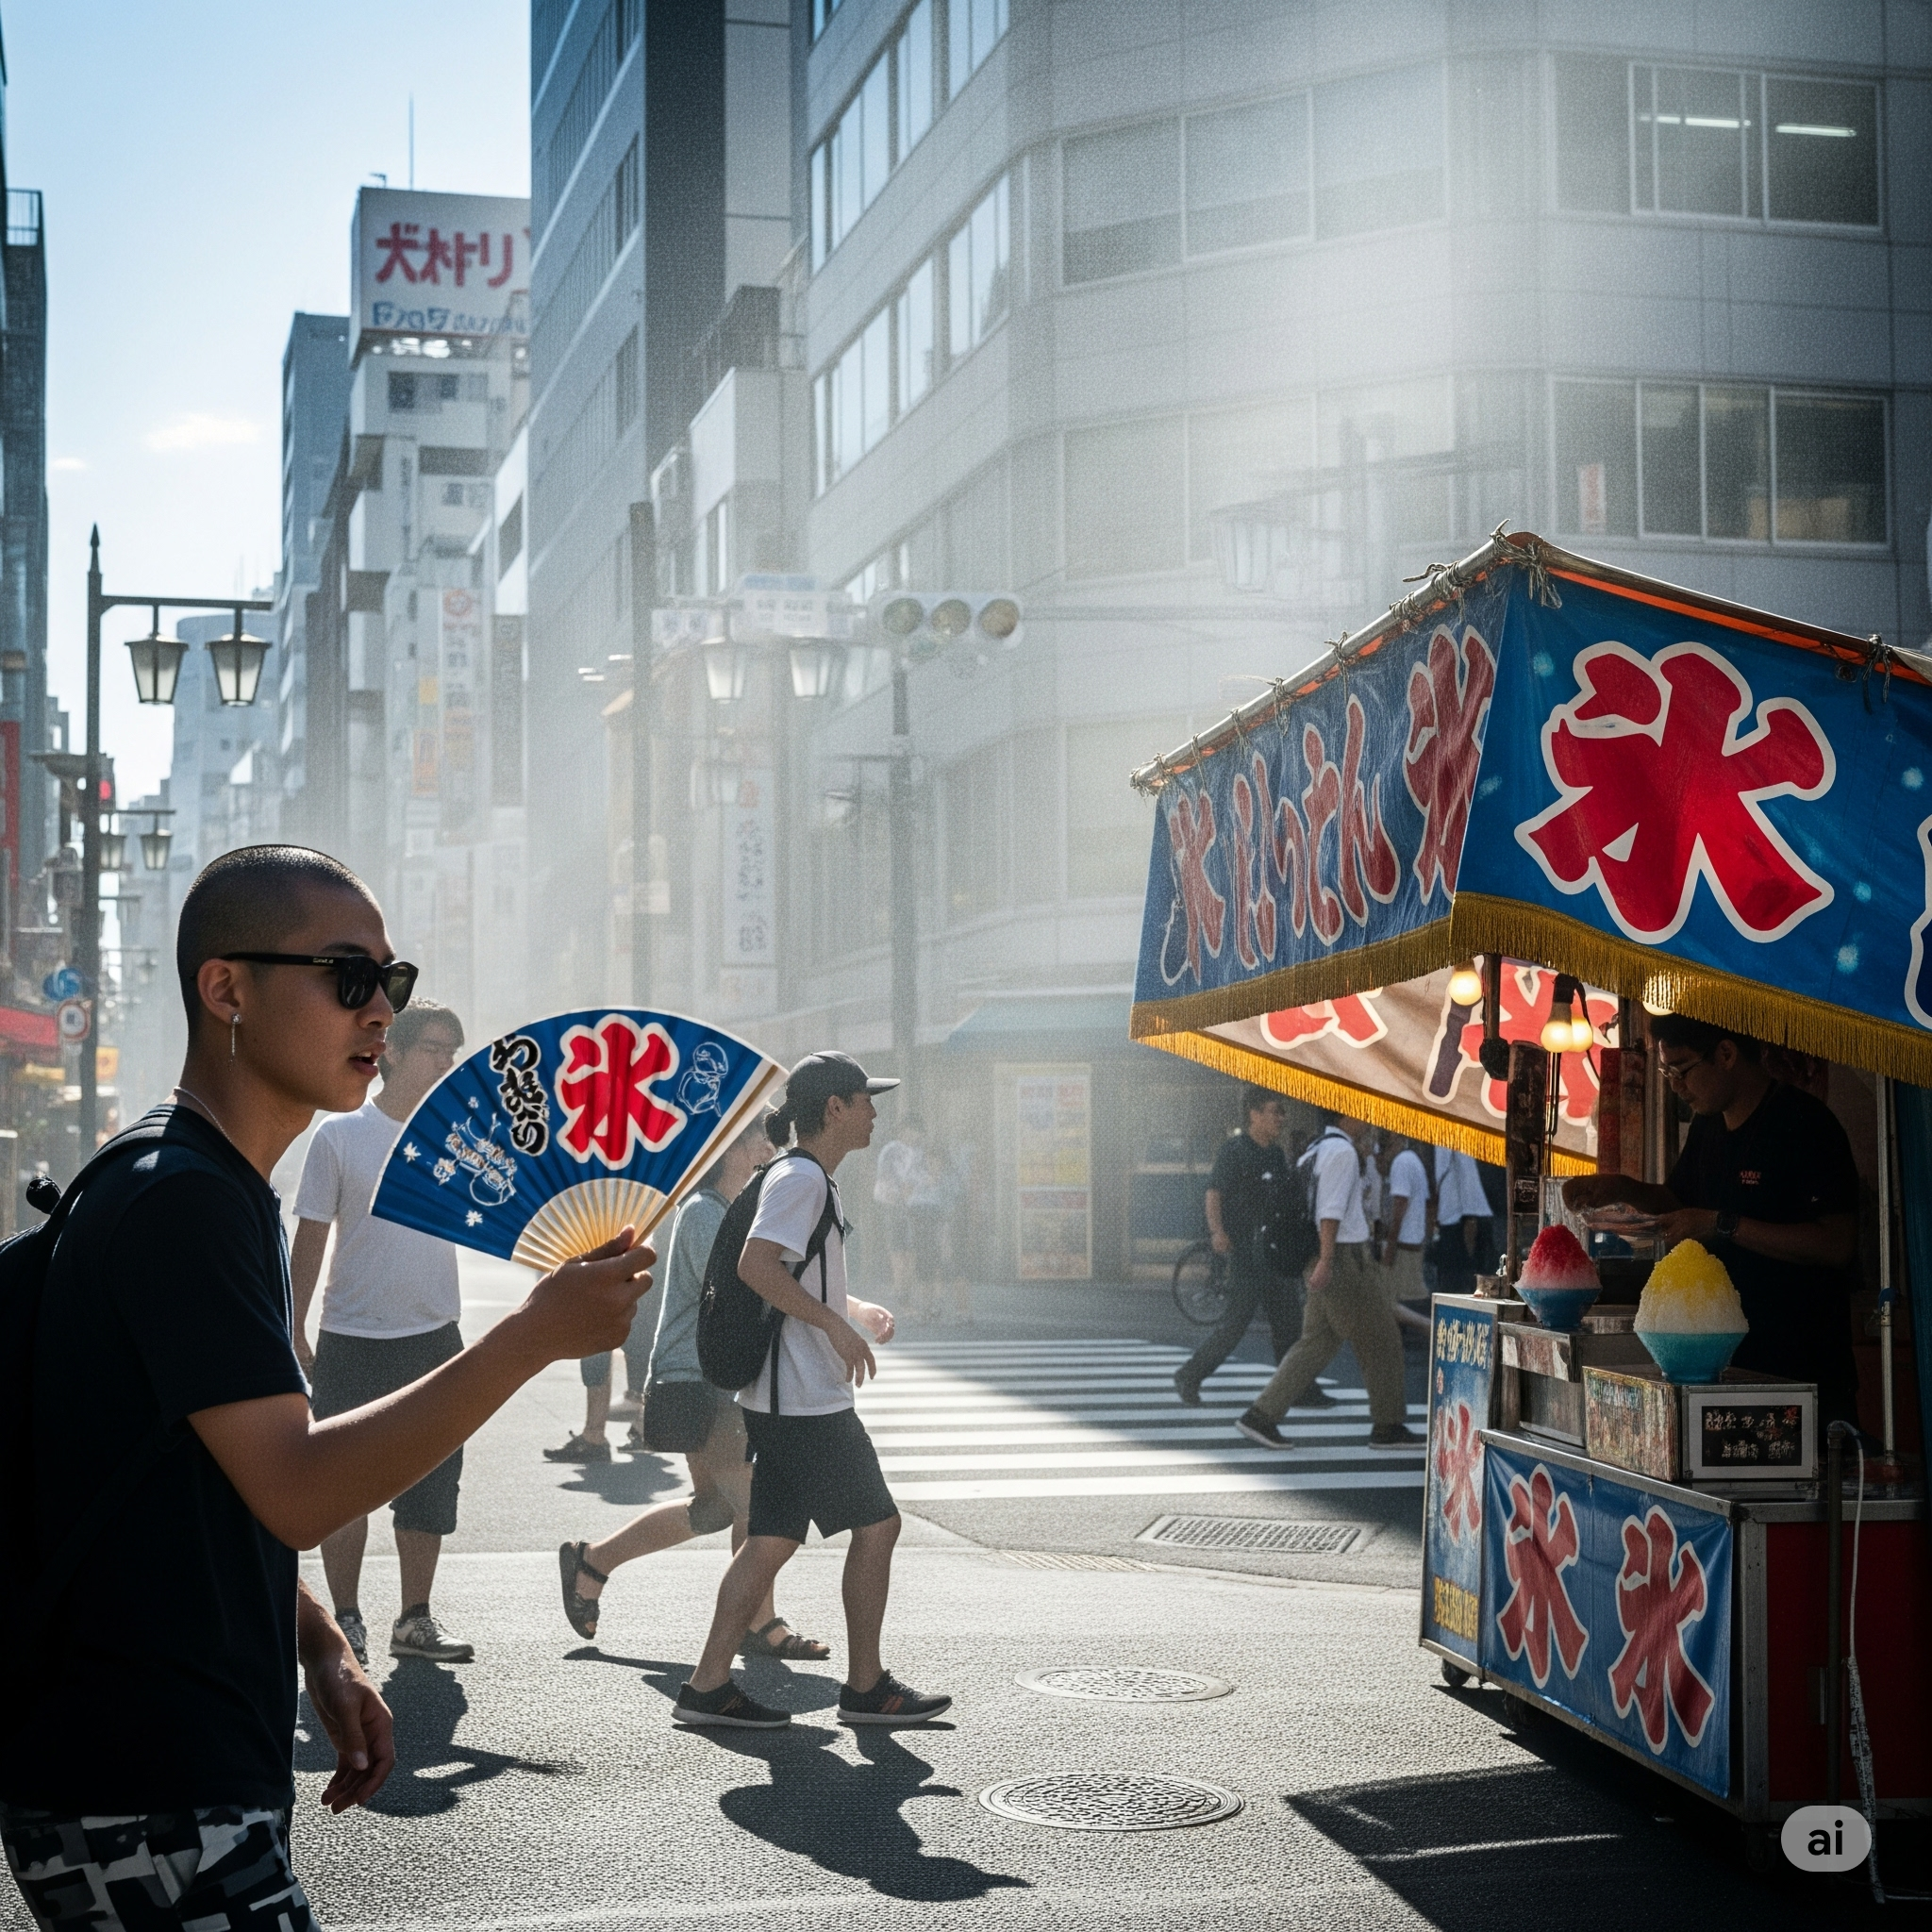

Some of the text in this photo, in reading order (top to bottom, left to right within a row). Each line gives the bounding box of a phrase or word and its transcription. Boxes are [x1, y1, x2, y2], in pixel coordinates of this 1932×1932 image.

[1513, 641, 1836, 943] 氷
[555, 1013, 688, 1171] 氷
[1496, 1463, 1590, 1689] 氷
[1607, 1504, 1715, 1757] 氷
